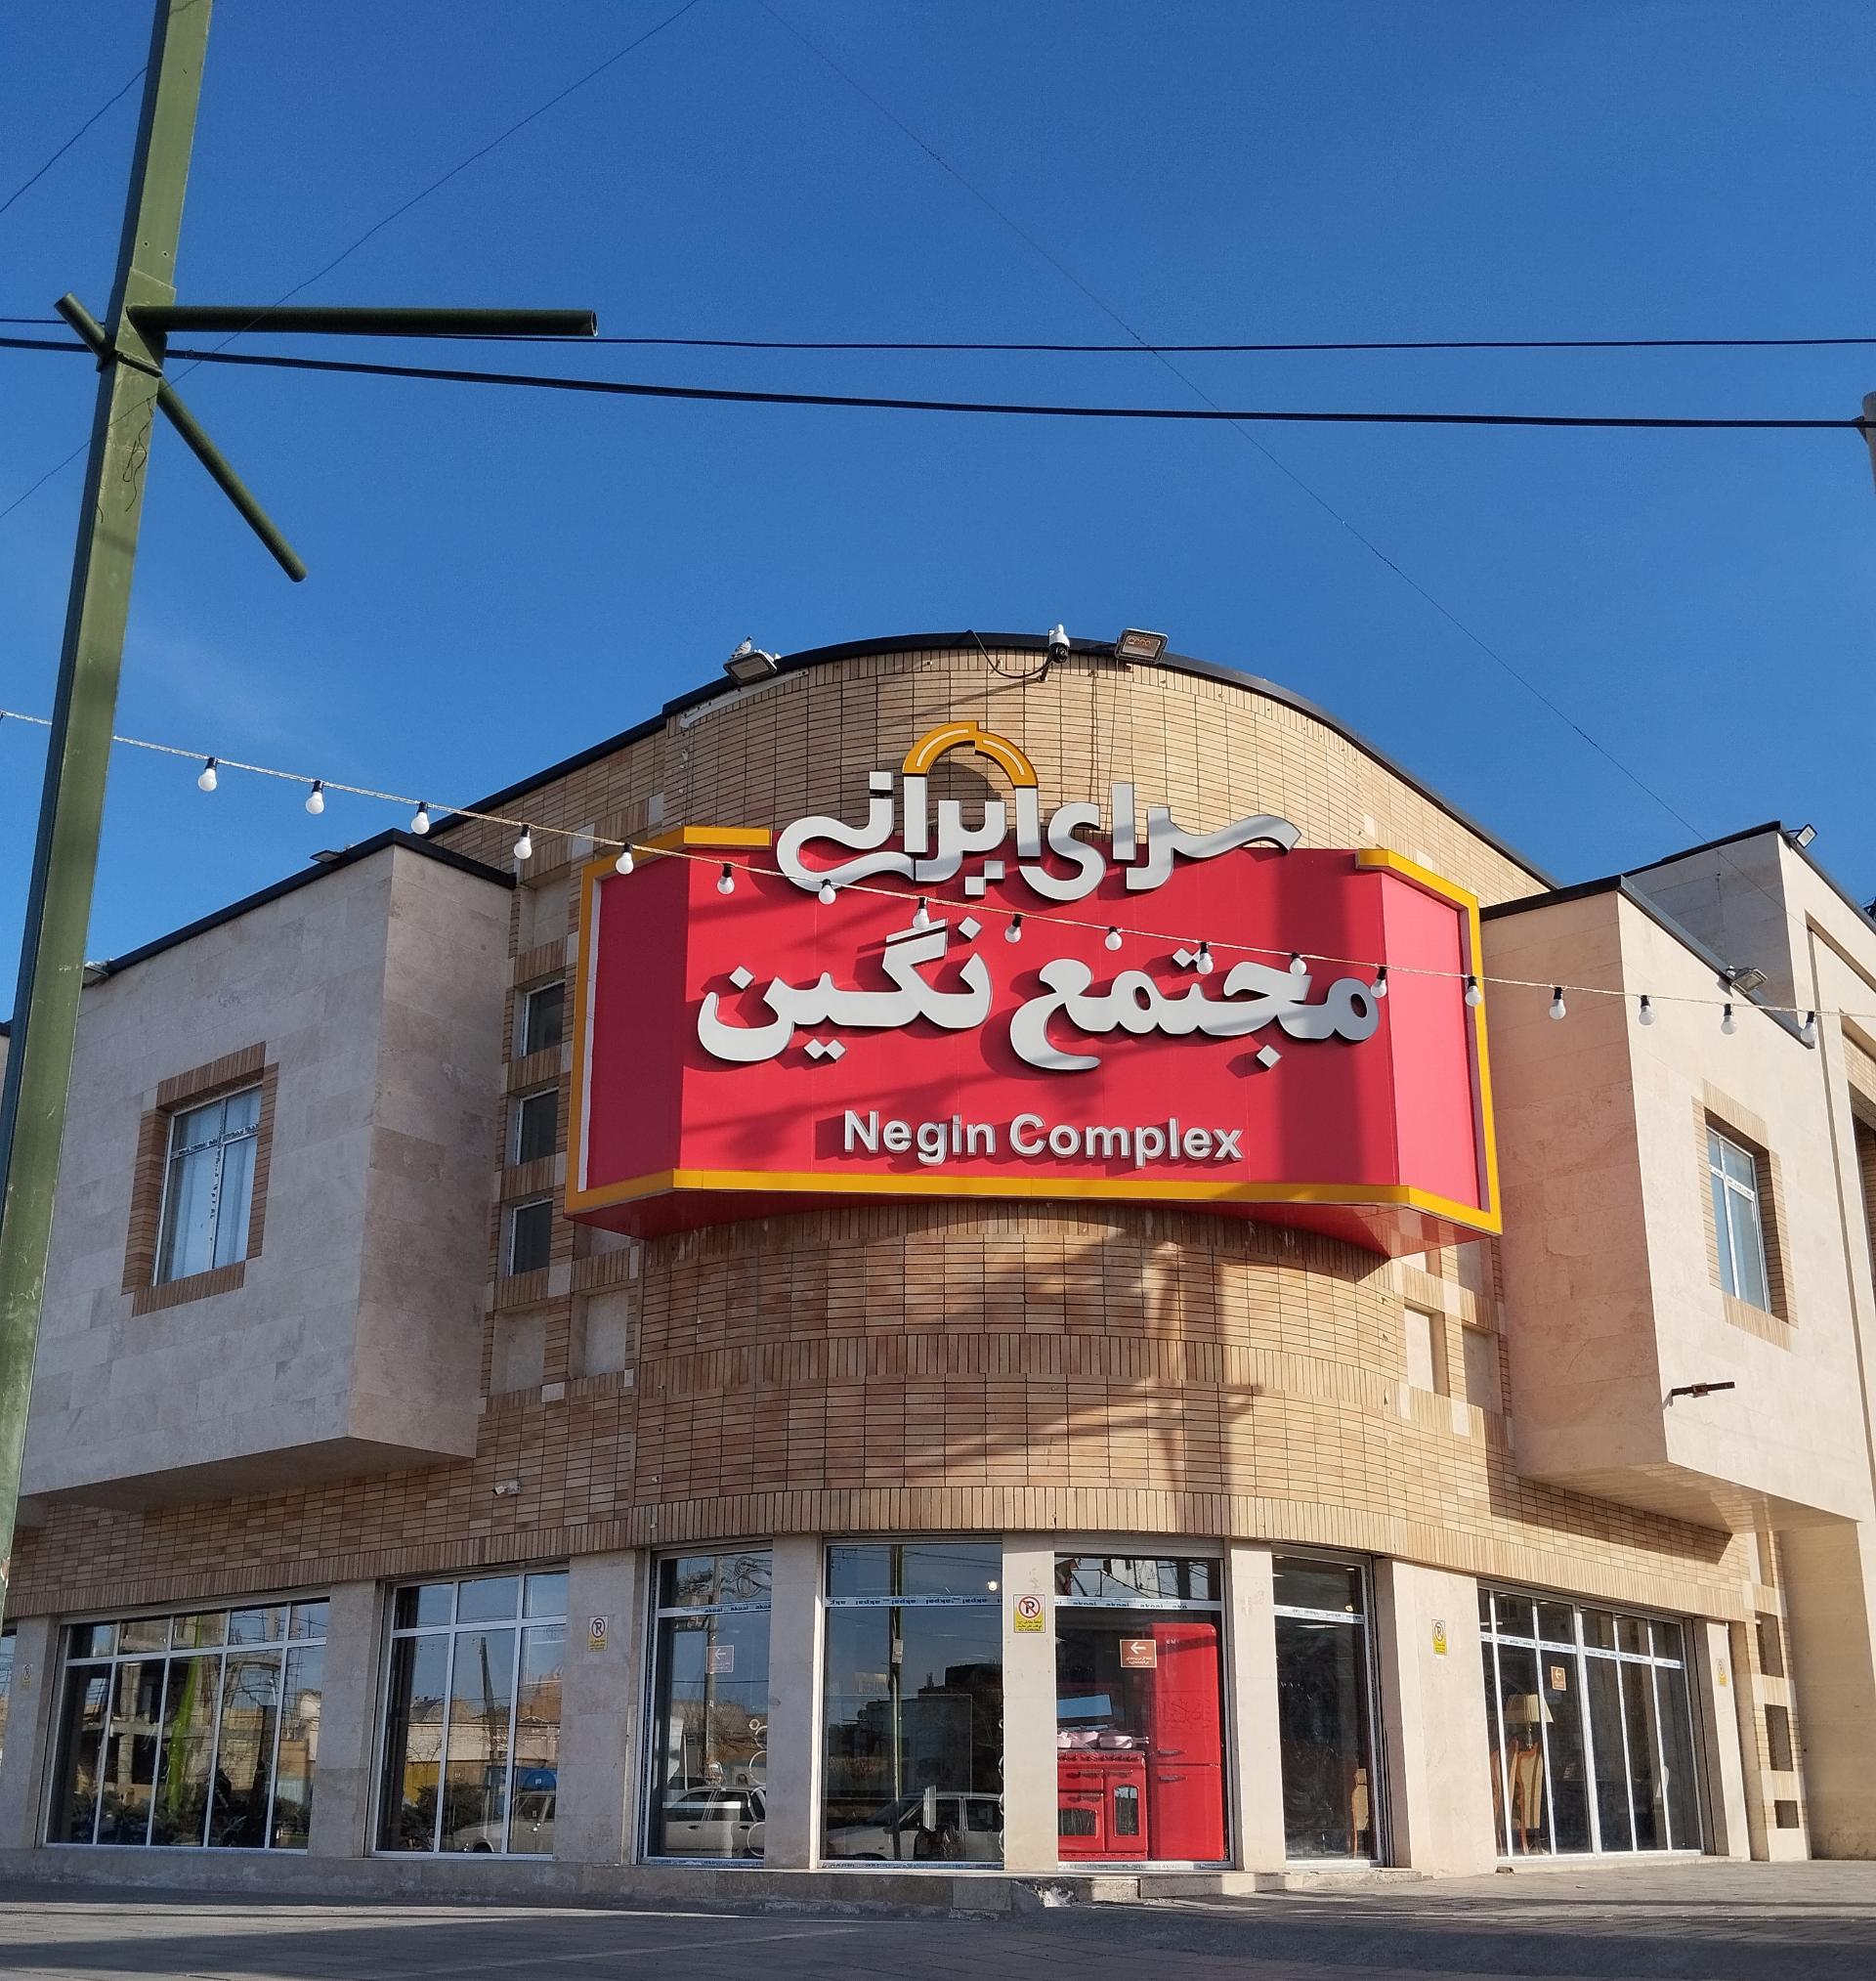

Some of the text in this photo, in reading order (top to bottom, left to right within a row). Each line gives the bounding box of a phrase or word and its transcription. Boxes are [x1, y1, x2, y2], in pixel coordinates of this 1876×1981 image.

[776, 768, 1303, 901] سرای ایرانی
[697, 915, 1381, 1071] مجتمع نگین
[843, 1108, 1245, 1170] Negin Complex
